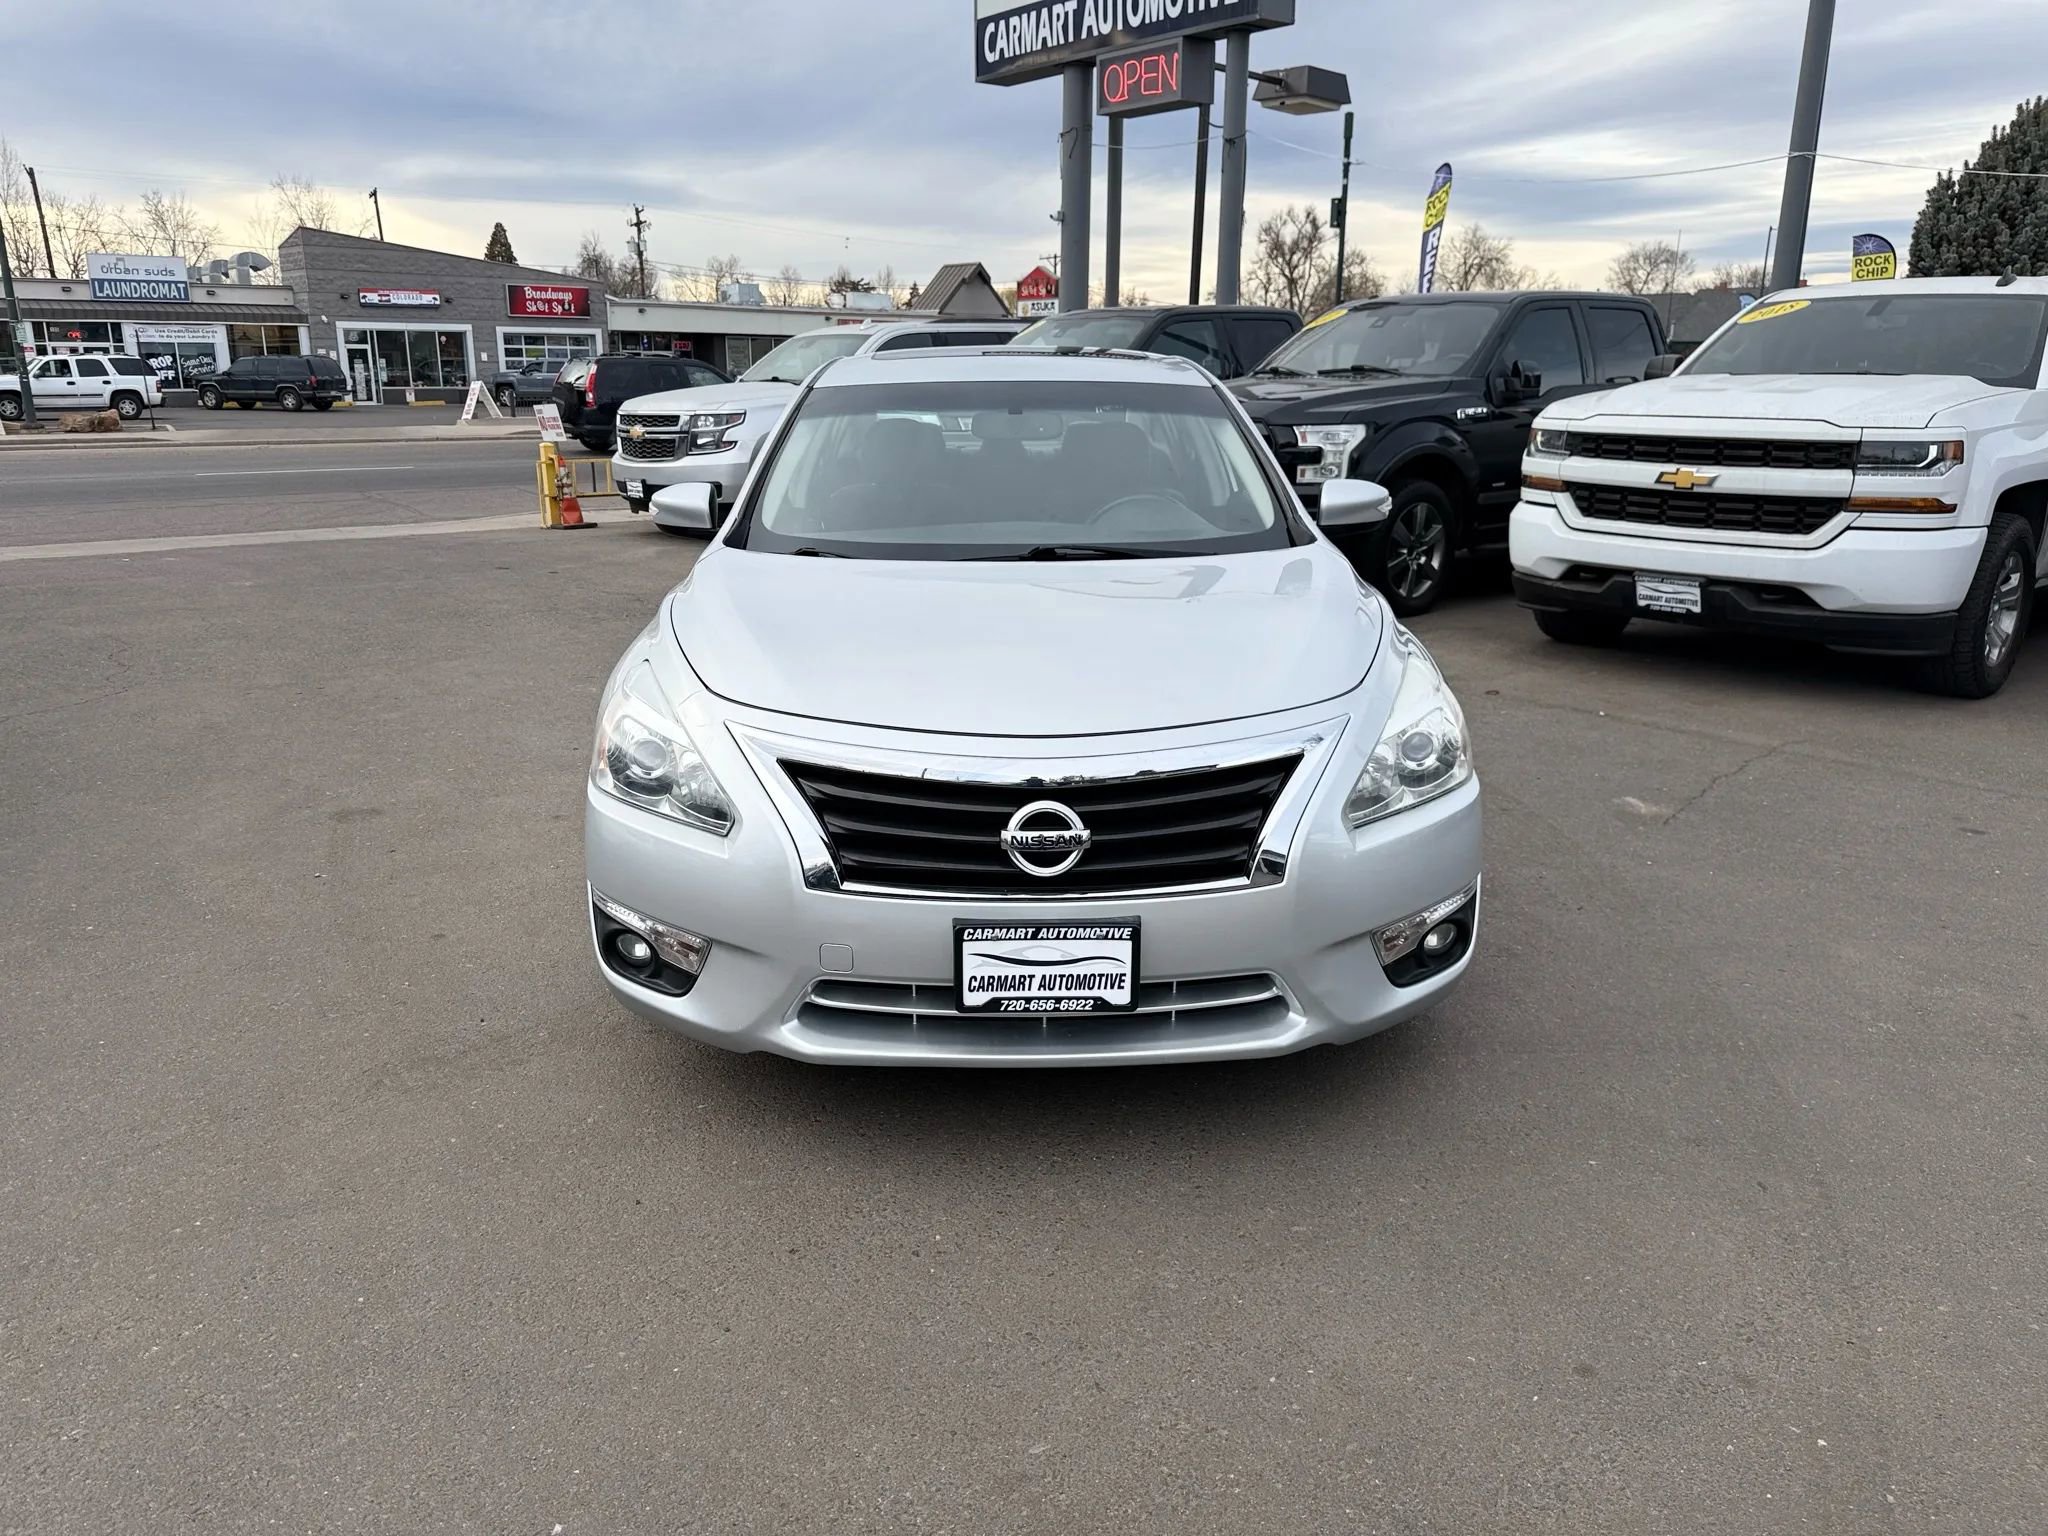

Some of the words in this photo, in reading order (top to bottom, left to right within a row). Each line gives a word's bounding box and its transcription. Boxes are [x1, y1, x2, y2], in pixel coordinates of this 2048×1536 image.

[984, 1, 1077, 63] CARMART
[1081, 0, 1239, 40] AUTOM
[1104, 52, 1179, 102] OPEN
[1855, 254, 1891, 268] ROCK
[145, 267, 175, 276] suds
[1856, 266, 1888, 279] CHIP
[95, 281, 185, 299] LAUNDROMAT
[524, 286, 572, 300] Broadways
[147, 355, 173, 370] ROP
[1010, 834, 1083, 848] NISSAN
[963, 928, 1036, 941] CARMART
[1038, 927, 1133, 940] AUTOMOTIVE
[968, 974, 1036, 993] CARMART
[1038, 973, 1127, 992] AUTOMOTIVE
[1000, 999, 1094, 1011] 720-656-6922
